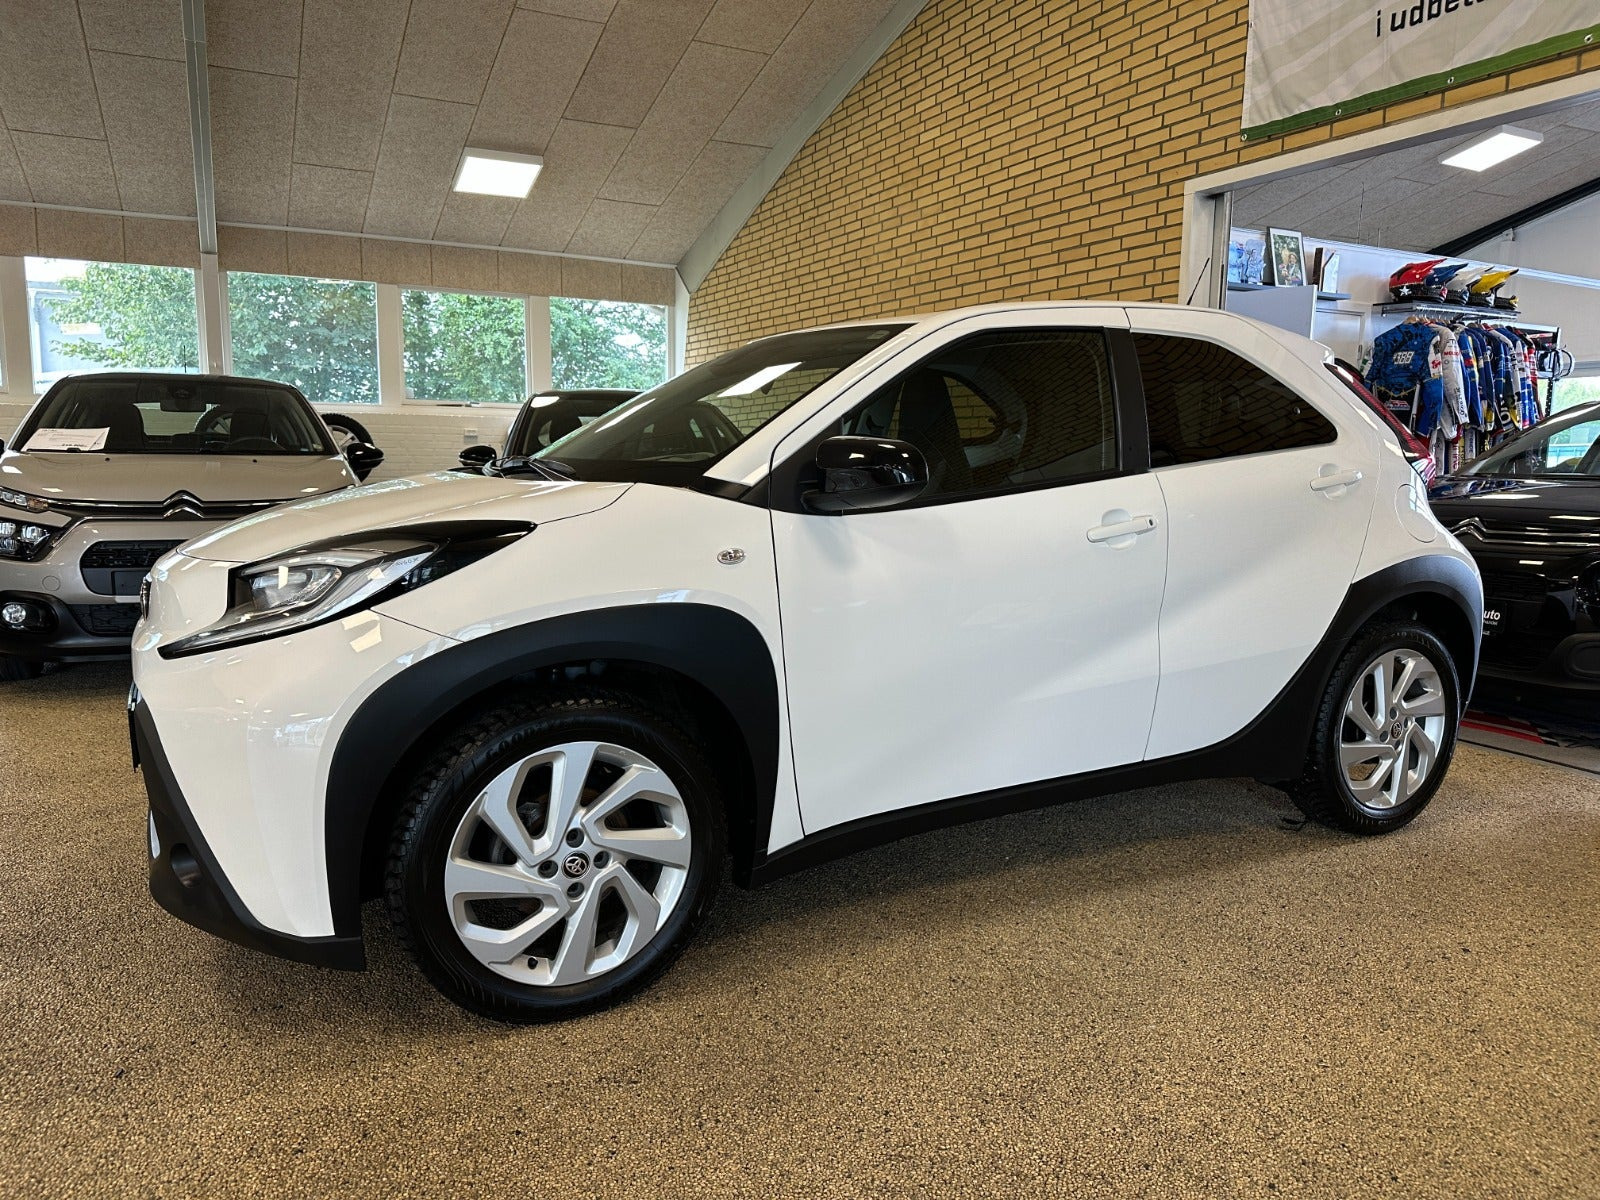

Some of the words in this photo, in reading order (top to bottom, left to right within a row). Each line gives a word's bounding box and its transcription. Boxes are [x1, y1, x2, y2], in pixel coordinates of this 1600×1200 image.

[1376, 9, 1381, 38] i
[1390, 0, 1487, 32] udbe
[1483, 610, 1500, 620] uto
